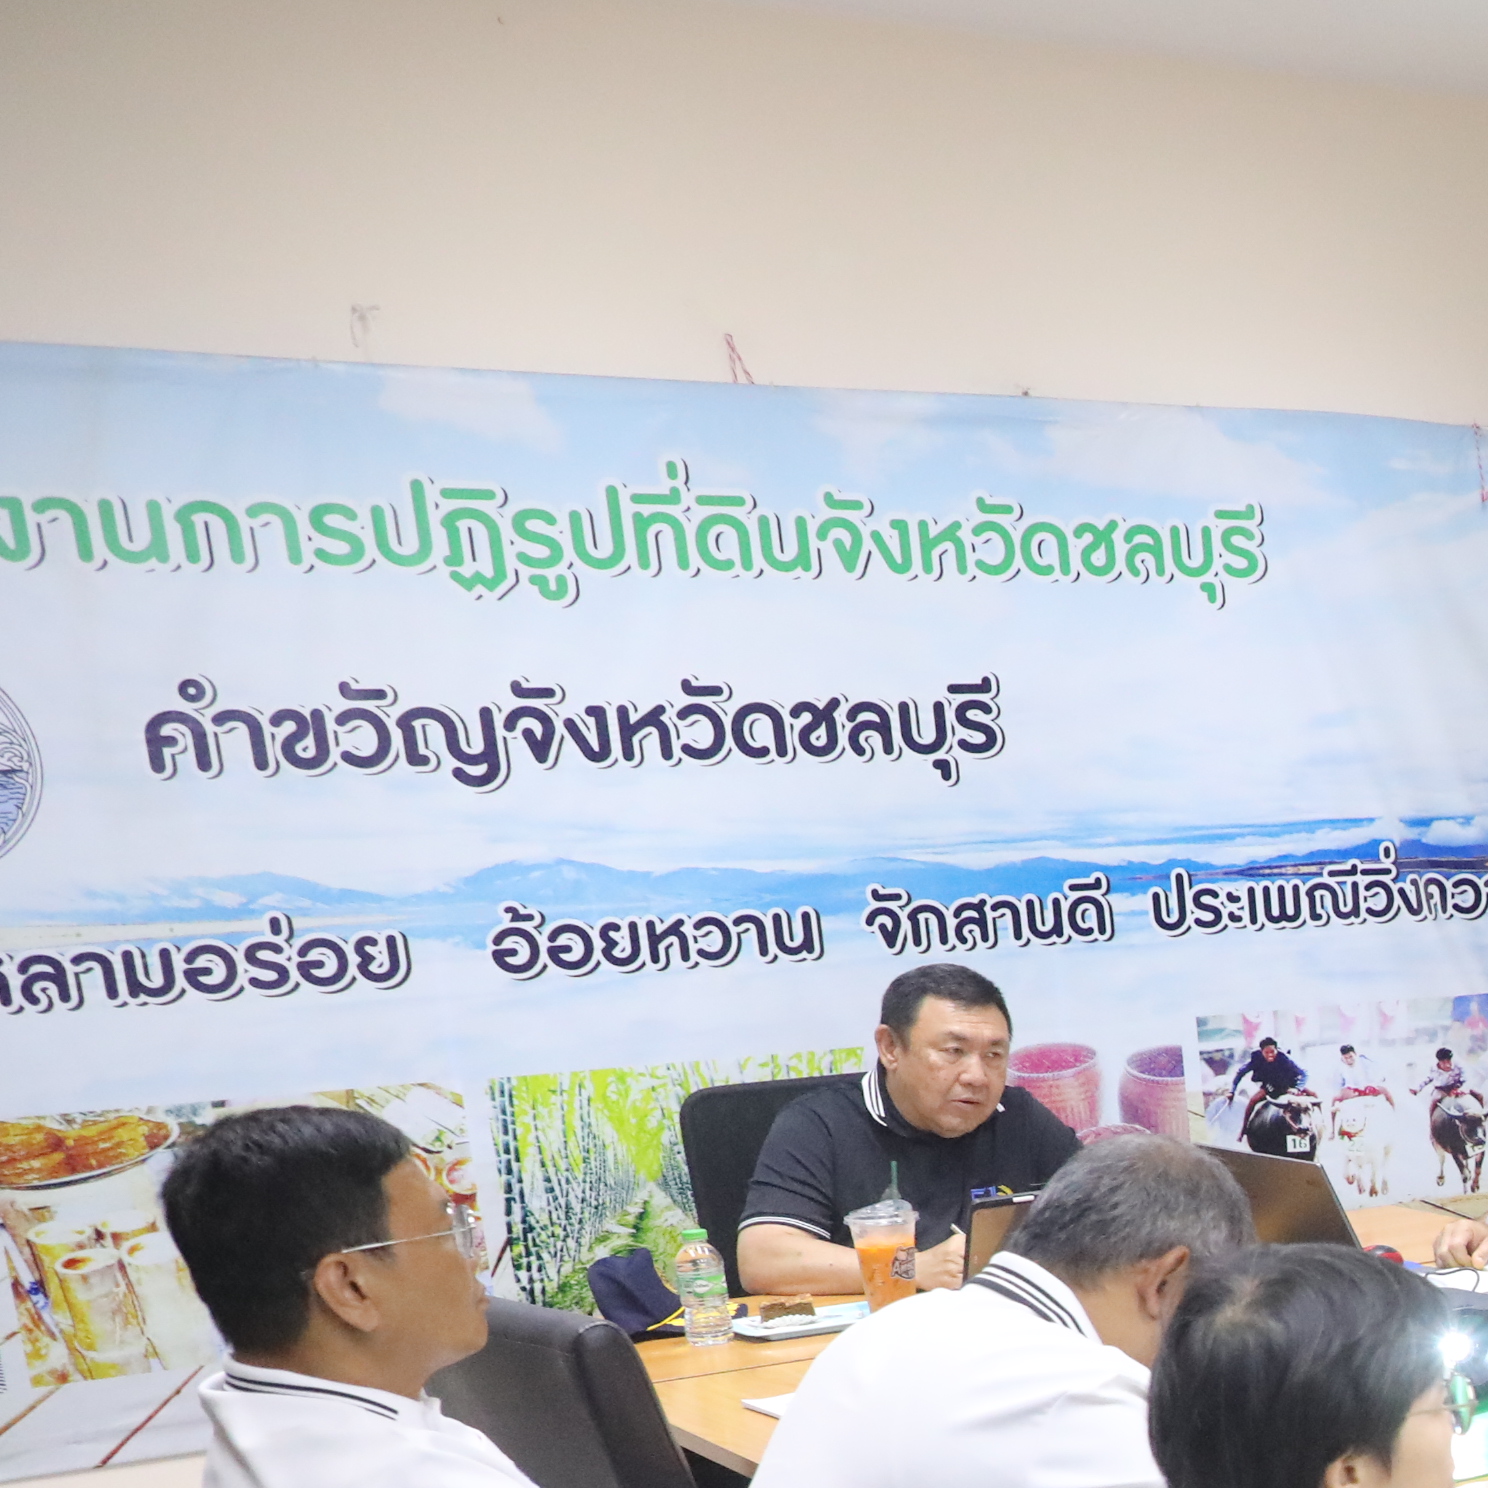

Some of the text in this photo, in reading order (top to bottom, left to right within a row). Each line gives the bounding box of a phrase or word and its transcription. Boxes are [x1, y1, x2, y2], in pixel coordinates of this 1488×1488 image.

[144, 676, 1003, 790] คำขวัญจังหวัดชลบุรี
[0, 915, 406, 1009] ลามอร่อย
[491, 904, 820, 977] อ้อยหวาน
[864, 875, 1112, 951] จักสานดี
[1291, 1138, 1308, 1149] 16
